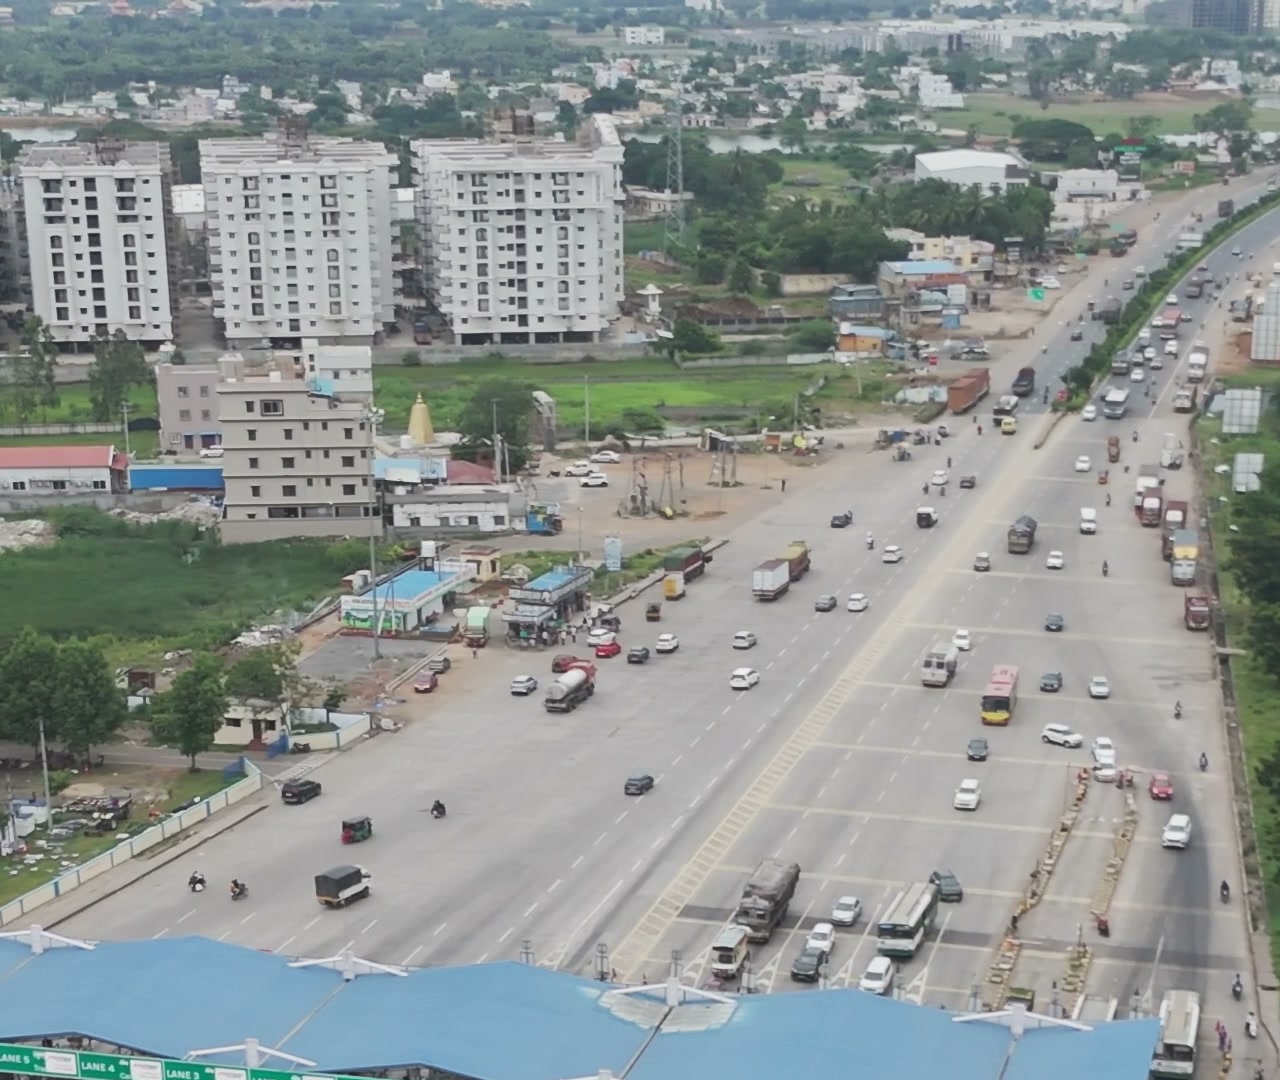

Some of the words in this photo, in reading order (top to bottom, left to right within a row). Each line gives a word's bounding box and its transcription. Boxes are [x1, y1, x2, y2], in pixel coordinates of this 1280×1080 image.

[23, 1056, 30, 1064] 5
[81, 1062, 106, 1072] LANE
[166, 1070, 192, 1080] LANE
